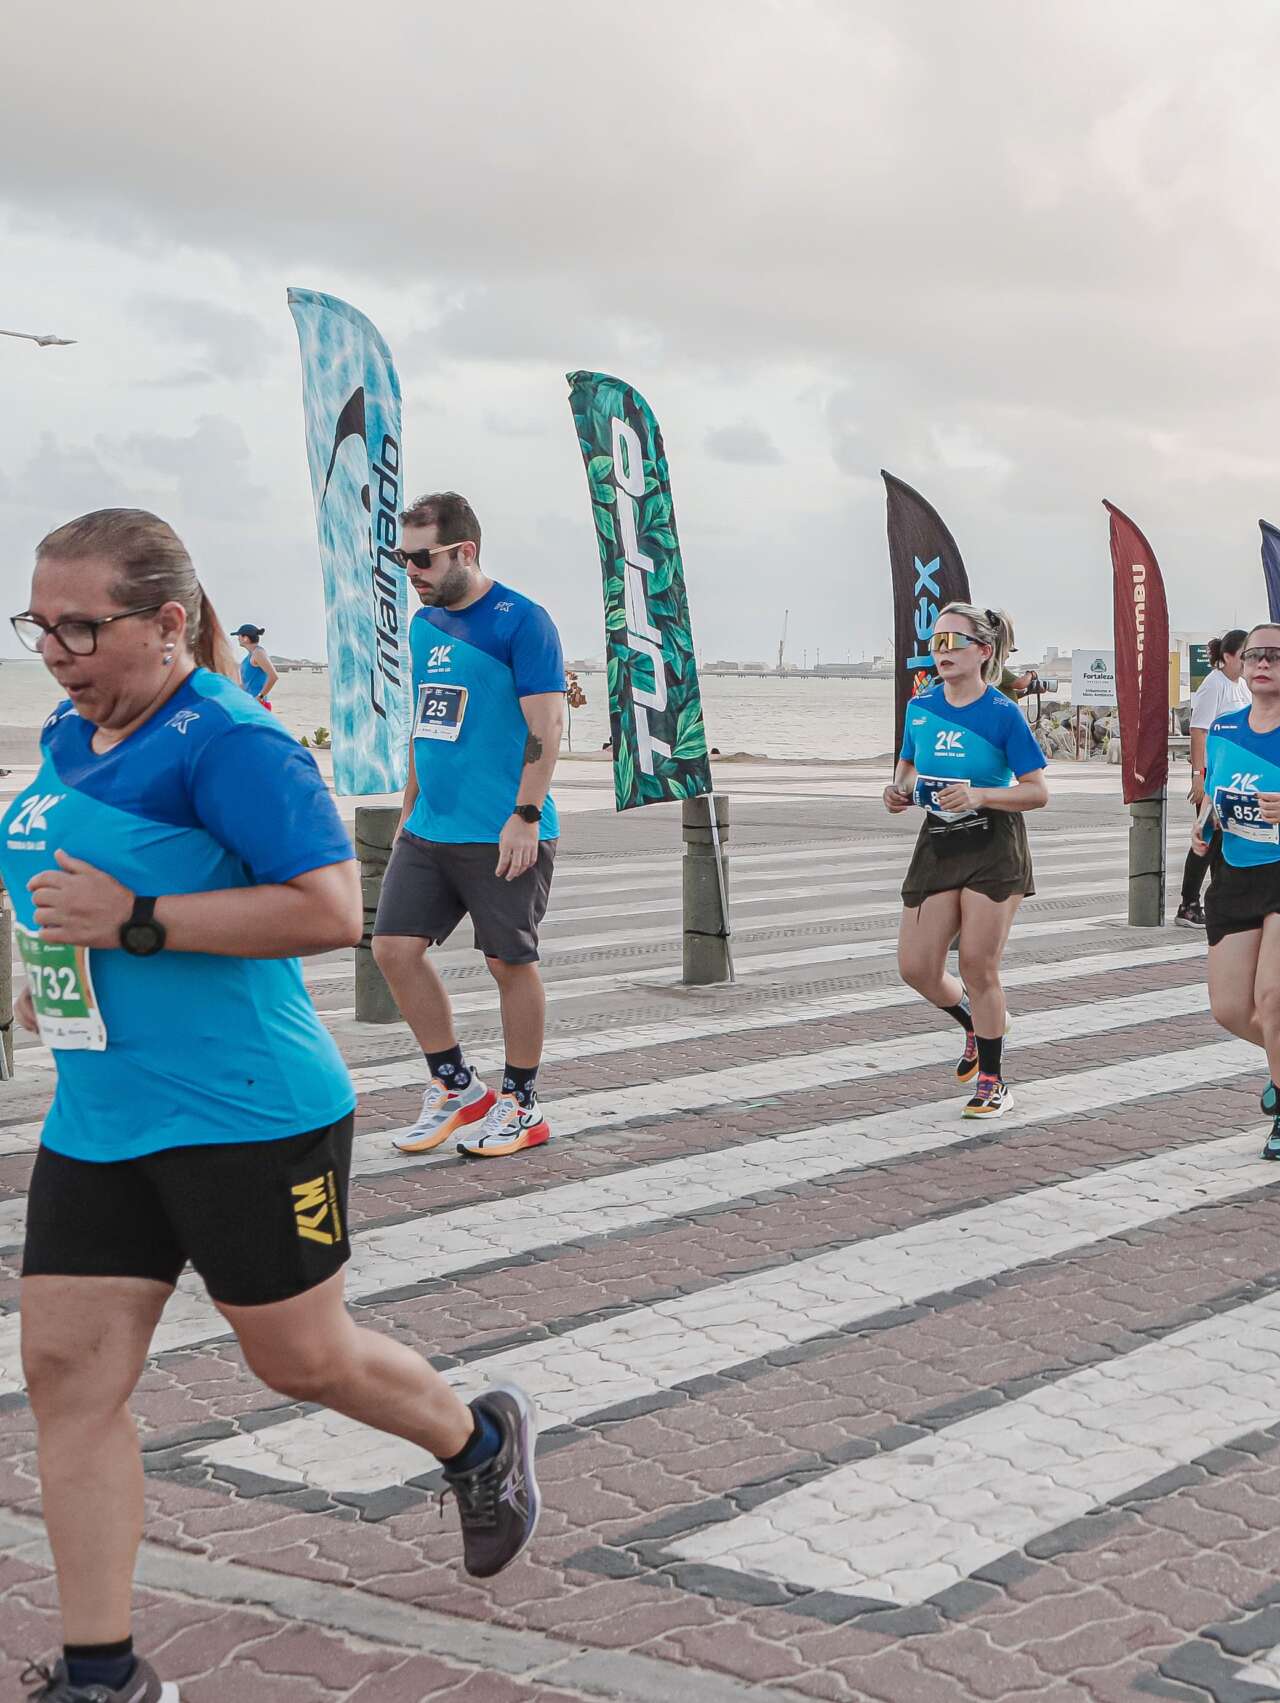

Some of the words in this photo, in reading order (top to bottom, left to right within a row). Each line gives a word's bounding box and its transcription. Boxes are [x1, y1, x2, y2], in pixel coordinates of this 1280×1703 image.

[610, 415, 670, 776] TUFFO
[425, 700, 448, 717] 25
[1233, 805, 1264, 822] 852
[27, 962, 81, 1001] 732
